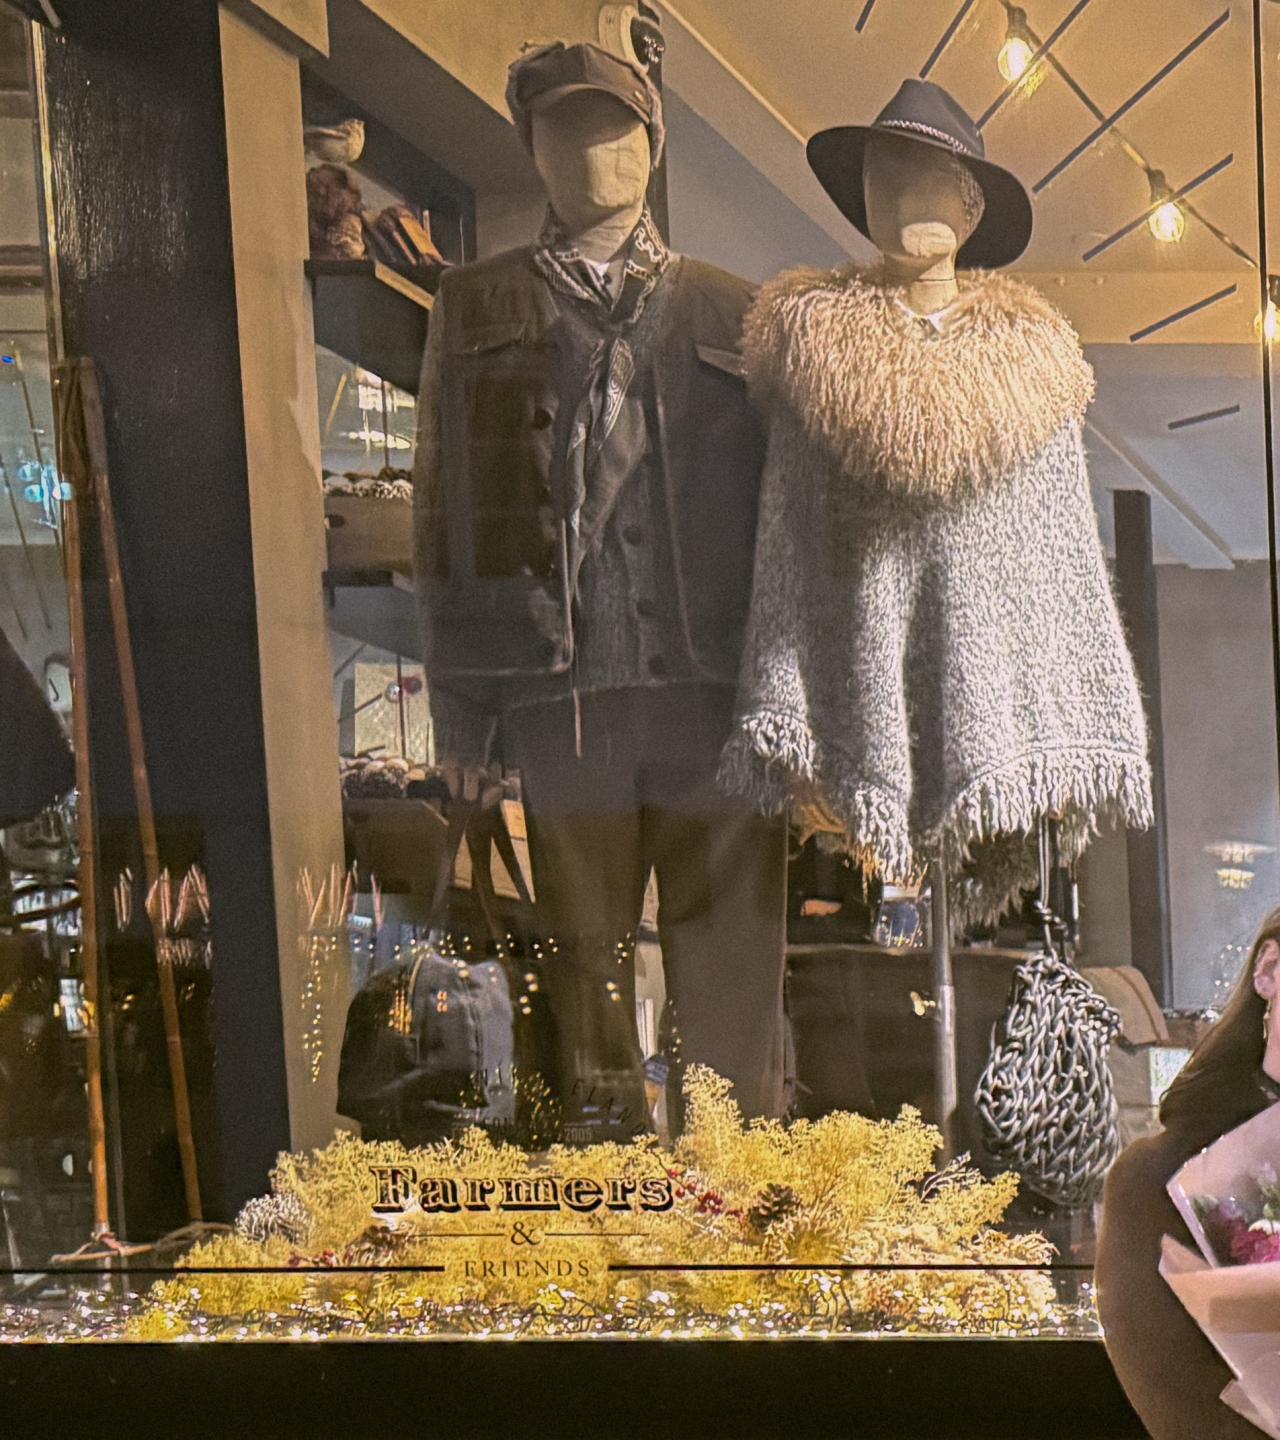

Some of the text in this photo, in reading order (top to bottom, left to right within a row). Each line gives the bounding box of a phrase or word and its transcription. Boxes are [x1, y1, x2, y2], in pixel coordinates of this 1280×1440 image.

[369, 1165, 675, 1213] Farmers
[510, 1222, 541, 1246] &
[464, 1259, 591, 1278] FRIENDS
